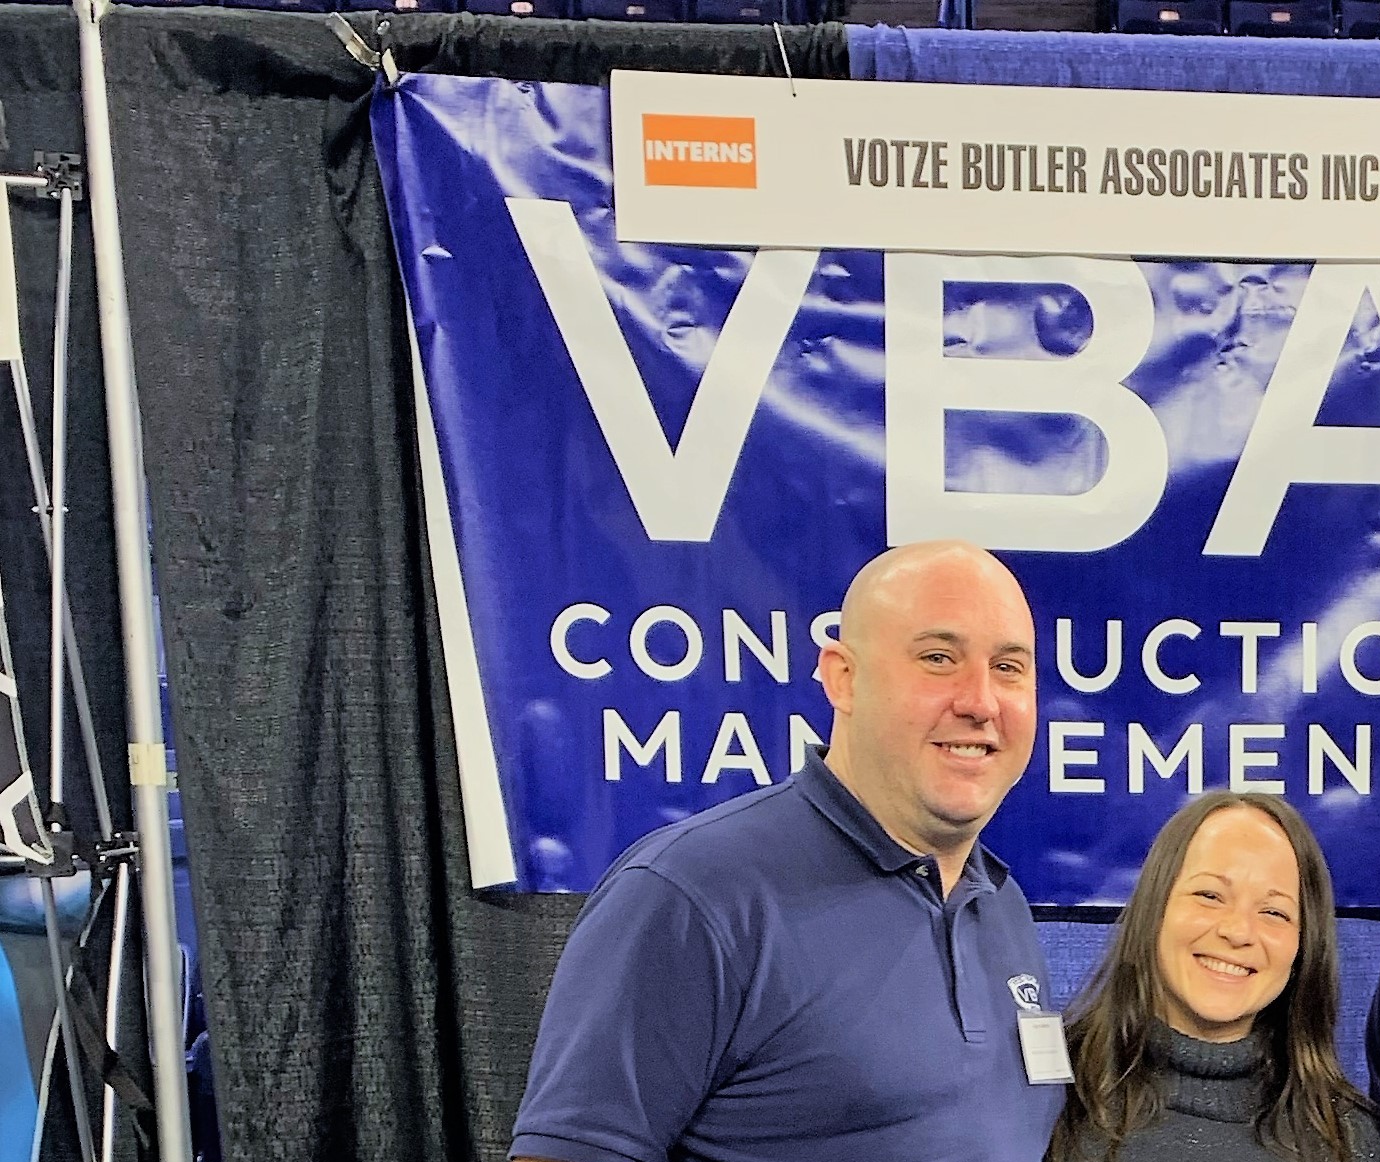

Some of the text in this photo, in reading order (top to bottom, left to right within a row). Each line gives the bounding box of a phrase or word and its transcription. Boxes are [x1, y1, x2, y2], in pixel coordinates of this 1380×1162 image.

[645, 139, 754, 164] INTERNS
[843, 137, 1380, 202] VOTZE BUTLER ASSOCIATES INC
